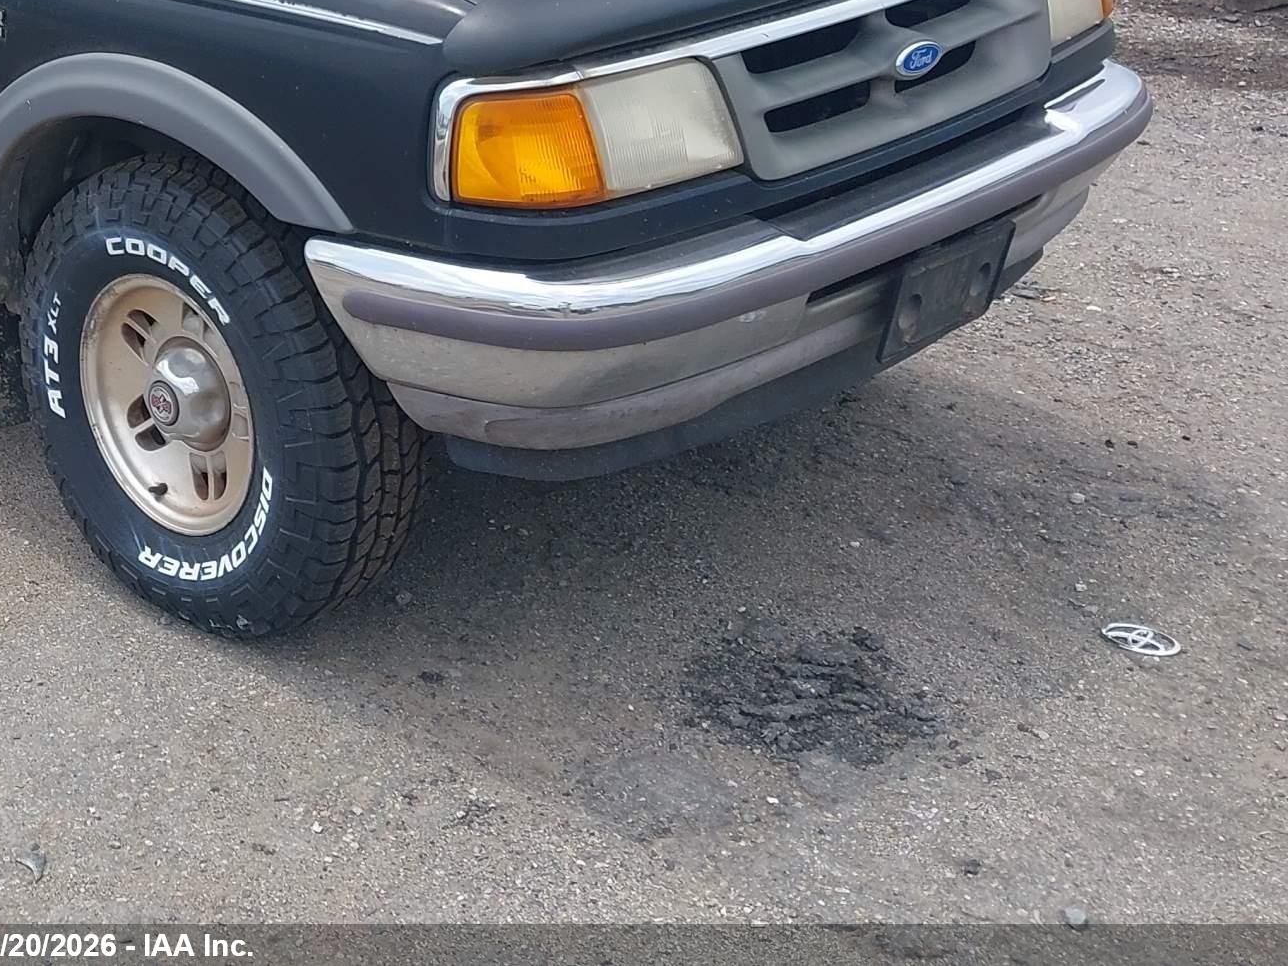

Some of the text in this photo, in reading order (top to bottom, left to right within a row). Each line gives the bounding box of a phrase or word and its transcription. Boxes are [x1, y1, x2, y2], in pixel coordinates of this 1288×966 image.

[909, 48, 933, 70] Ford
[104, 236, 231, 326] COOPER
[41, 292, 67, 418] AT3 XLT
[138, 465, 273, 581] DISCOVERER
